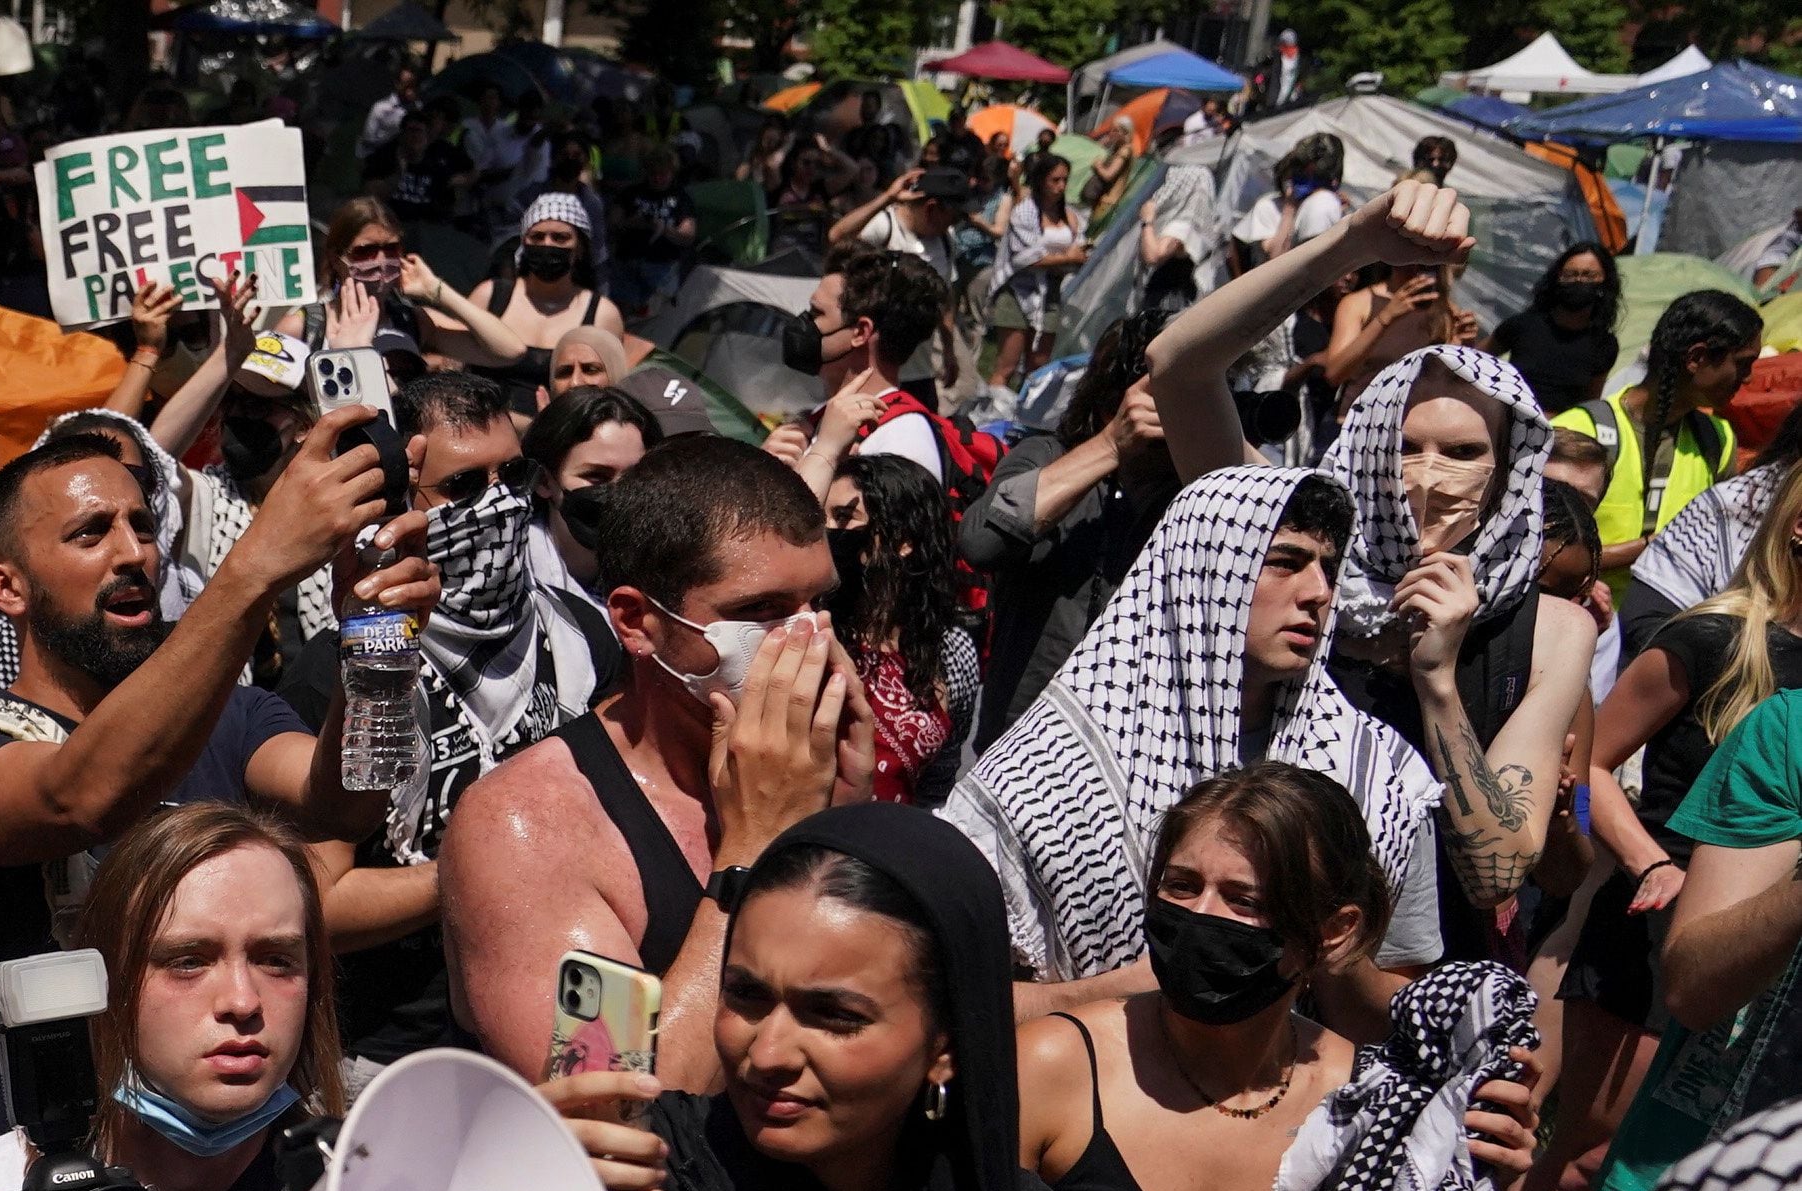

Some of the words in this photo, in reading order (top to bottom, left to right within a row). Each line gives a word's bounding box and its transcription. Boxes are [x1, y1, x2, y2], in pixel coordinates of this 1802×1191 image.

[55, 133, 232, 222] FREE
[60, 204, 196, 280] FREE
[363, 623, 405, 639] DEER
[364, 636, 408, 653] PARK
[52, 1169, 95, 1184] Canon
